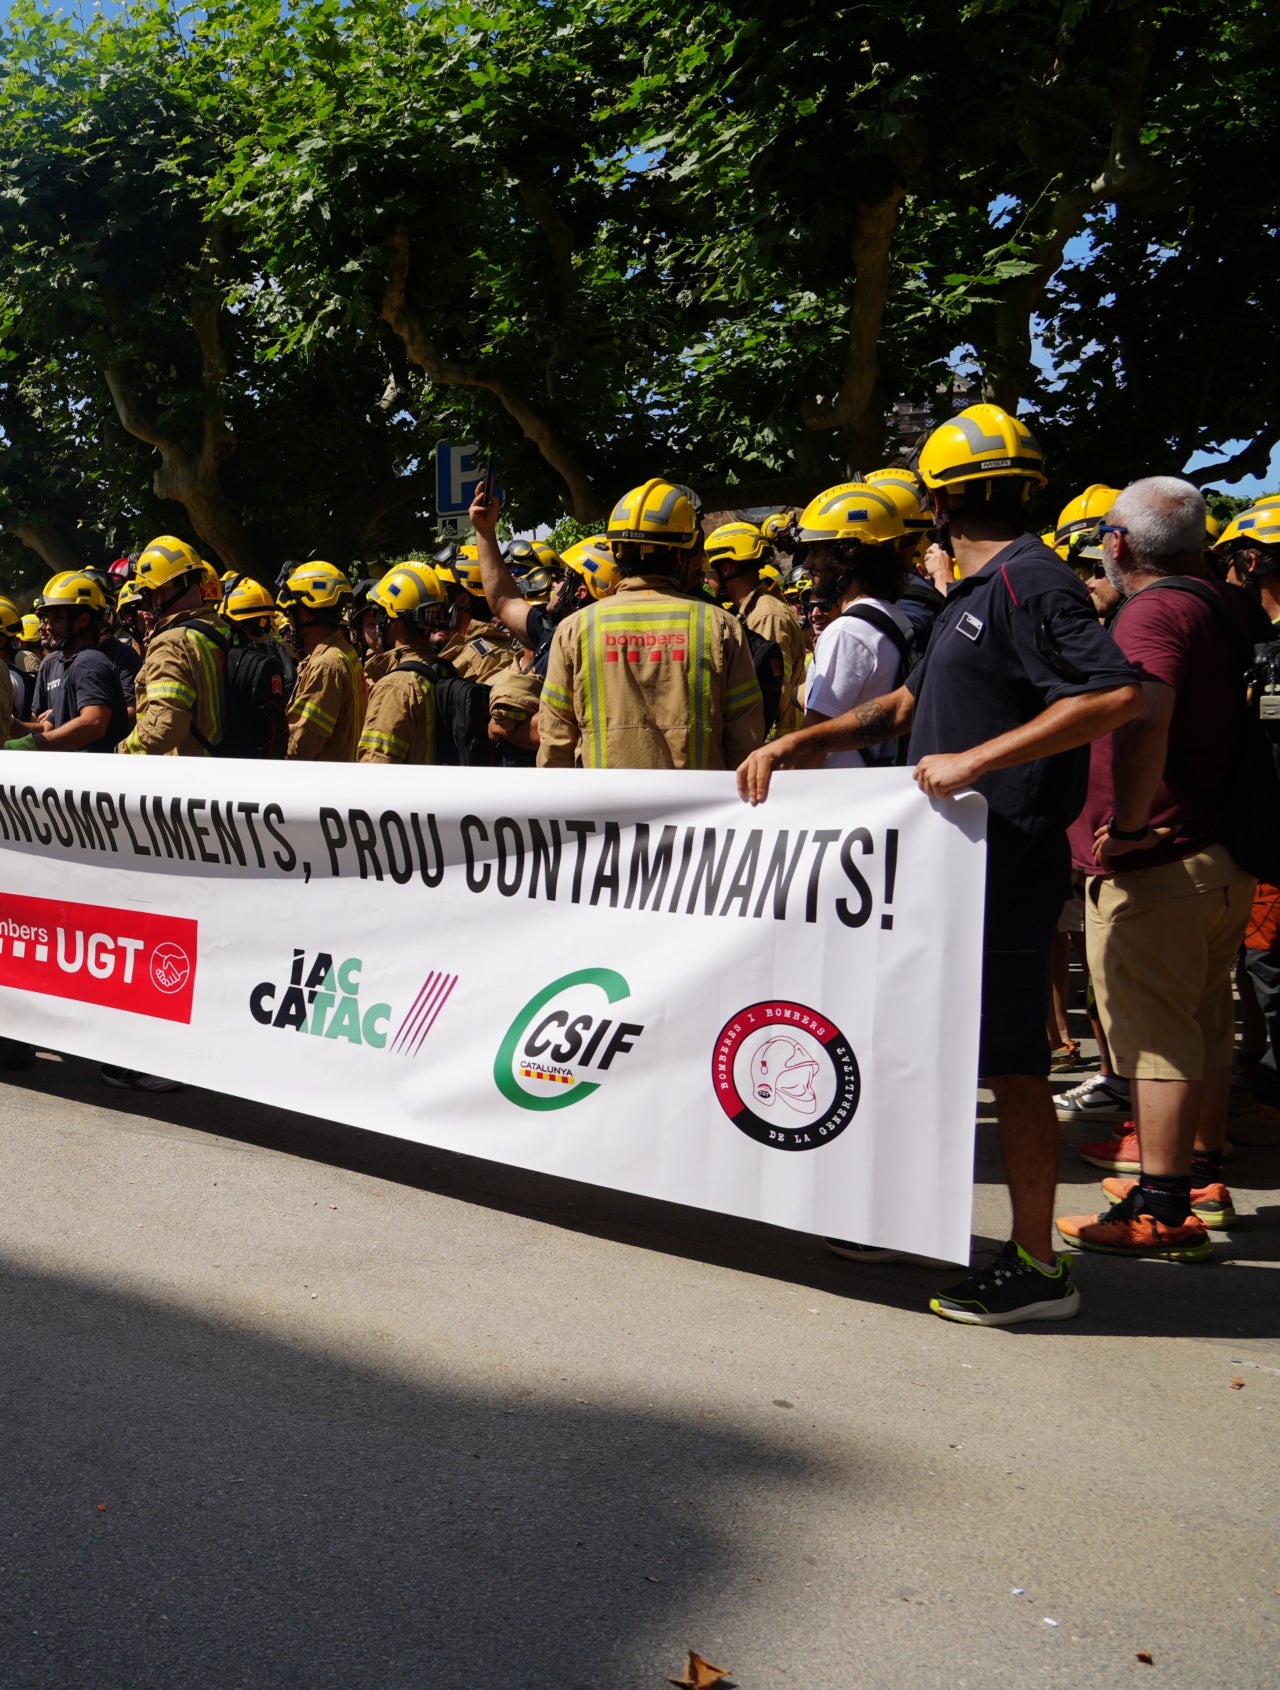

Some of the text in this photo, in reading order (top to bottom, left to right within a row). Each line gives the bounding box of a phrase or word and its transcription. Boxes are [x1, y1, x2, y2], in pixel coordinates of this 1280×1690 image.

[450, 444, 487, 504] P
[606, 632, 686, 646] bombers
[320, 807, 445, 888] PROU
[461, 814, 900, 931] CONTAMINANTS!
[56, 927, 145, 984] UGT
[249, 981, 393, 1049] CATAC
[523, 1010, 645, 1070] CSIF
[520, 1060, 574, 1078] CATALUNYA
[718, 1008, 826, 1090] BOMBERES I BOMBERS
[768, 1047, 856, 1144] DE LA GENERALITAT
